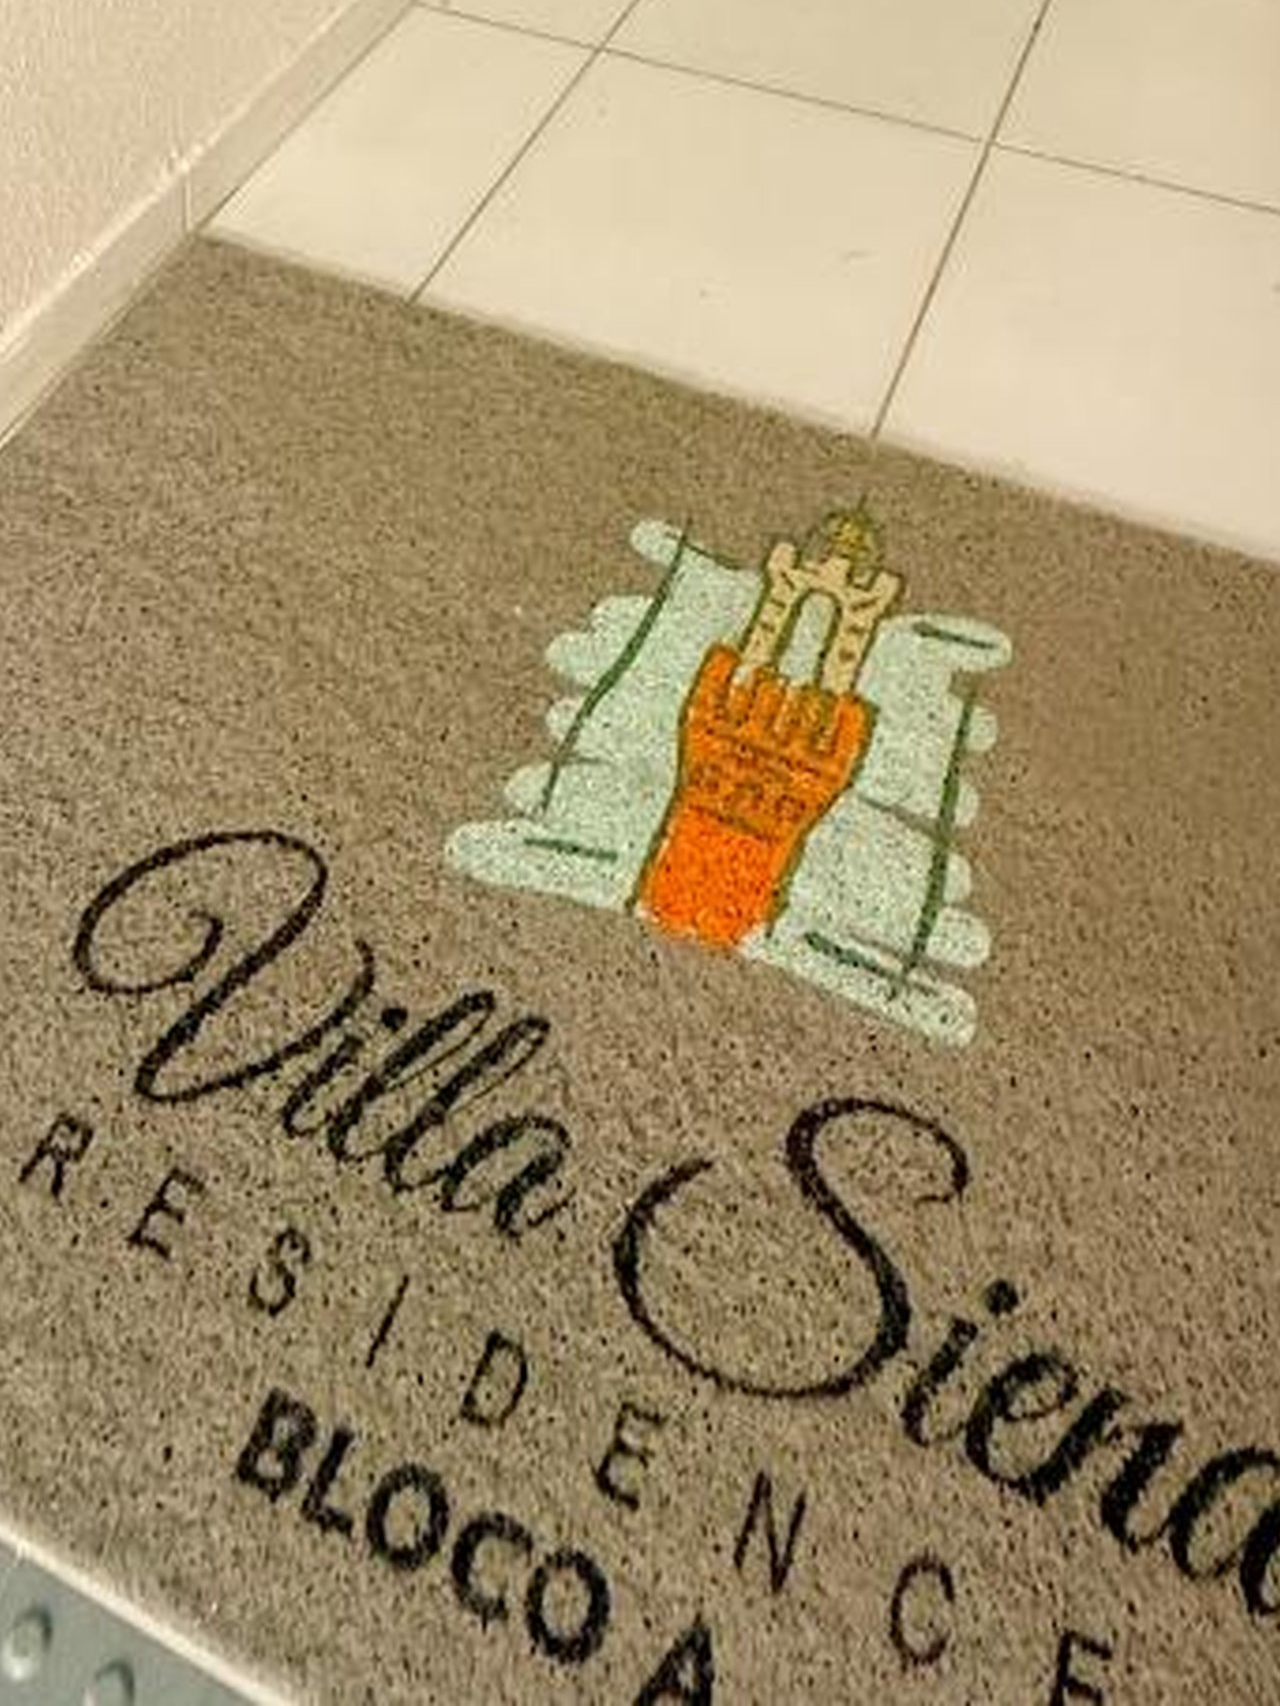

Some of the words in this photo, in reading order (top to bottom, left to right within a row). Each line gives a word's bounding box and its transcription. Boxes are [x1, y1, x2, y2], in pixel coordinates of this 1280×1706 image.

[72, 830, 577, 1239] Villa
[19, 1111, 1113, 1706] RESIDENCE
[234, 1388, 612, 1664] BLOCO
[632, 1613, 715, 1706] A
